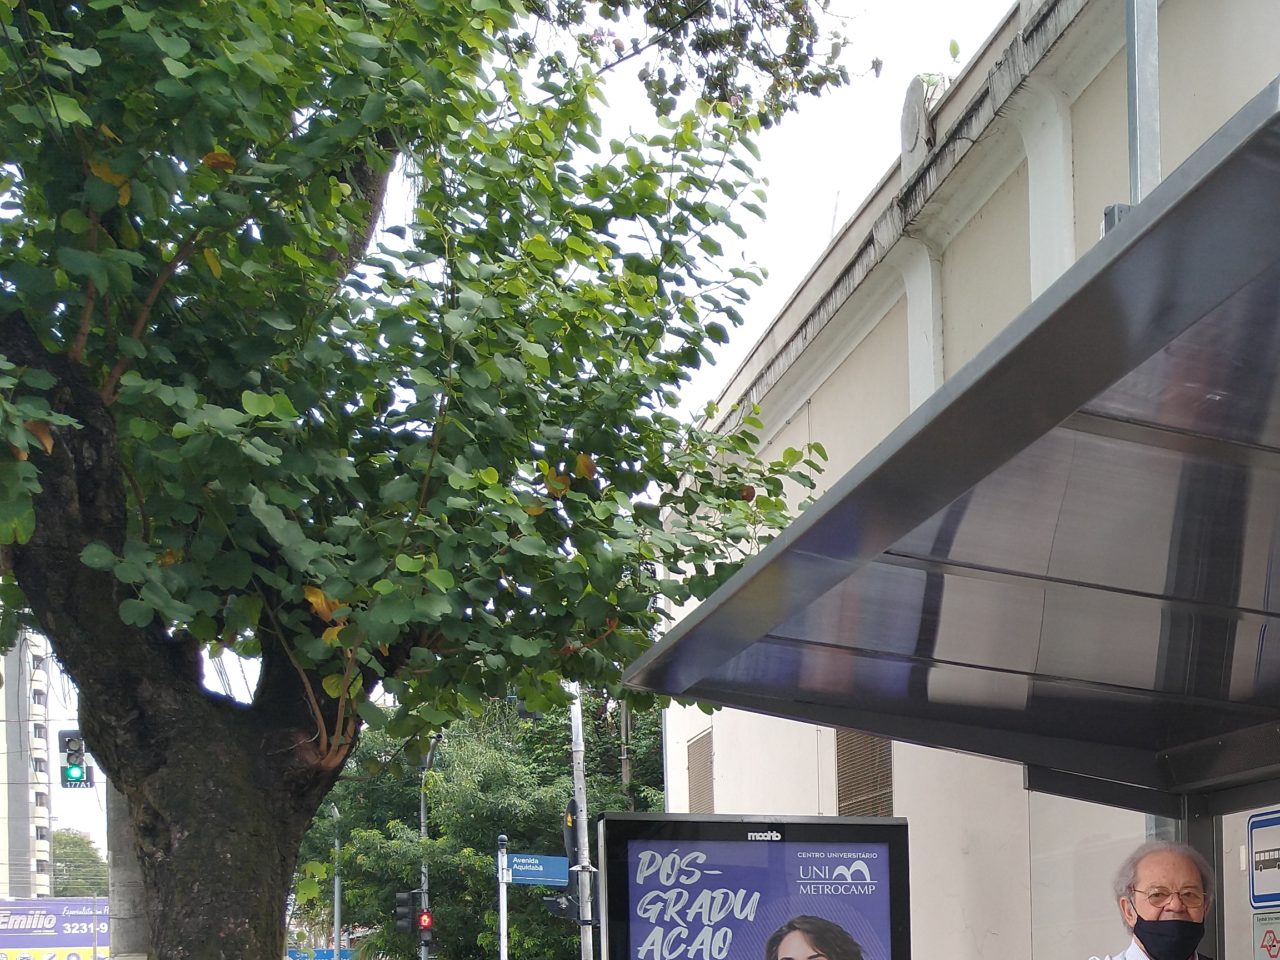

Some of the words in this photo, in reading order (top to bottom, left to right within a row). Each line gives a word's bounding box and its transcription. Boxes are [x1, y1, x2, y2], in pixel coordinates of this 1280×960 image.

[636, 848, 723, 886] PÓS-
[800, 866, 829, 879] UNI
[800, 884, 876, 894] METROCAMP
[637, 888, 760, 927] GRADU
[0, 910, 57, 929] Emilio
